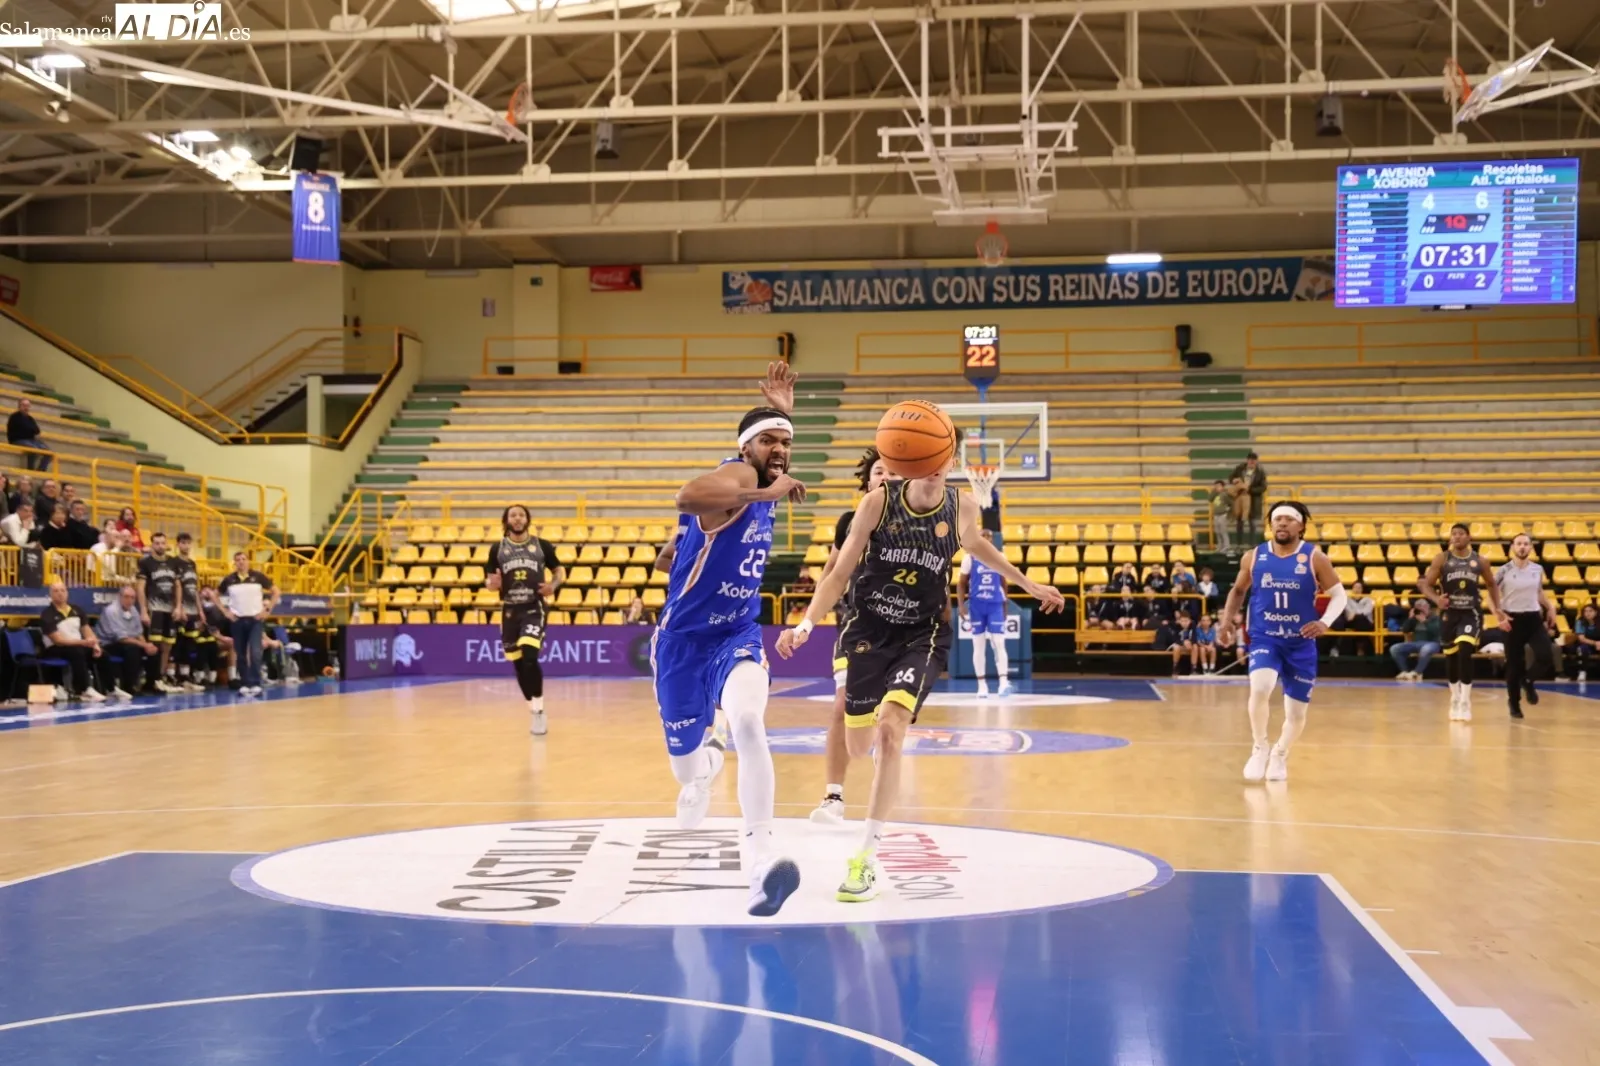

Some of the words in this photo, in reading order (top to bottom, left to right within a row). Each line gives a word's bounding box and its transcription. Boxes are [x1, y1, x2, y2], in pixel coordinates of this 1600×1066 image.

[1380, 166, 1435, 179] AVENIDA
[1483, 164, 1543, 175] Recoletas
[1373, 177, 1428, 189] XOBORG
[307, 191, 325, 224] 8
[1422, 193, 1435, 210] 4
[1475, 191, 1489, 209] 6
[1444, 215, 1467, 230] 1Q
[1420, 244, 1486, 267] 07:31
[773, 277, 925, 307] SALAMANCA
[932, 276, 986, 304] CON
[993, 274, 1041, 303] SUS
[1048, 270, 1139, 302] REINAS
[1146, 270, 1180, 299] DE
[1186, 267, 1289, 298] EUROPA
[1423, 273, 1434, 289] 0
[1475, 272, 1486, 288] 2
[965, 326, 996, 339] 07:31
[966, 345, 996, 367] 22
[739, 548, 766, 579] 22
[879, 547, 945, 575] CARBAJOSA
[513, 570, 527, 581] 32
[892, 568, 918, 585] 26
[1273, 591, 1288, 609] 11
[876, 603, 906, 618] salud
[1263, 611, 1300, 623] Xoborg
[525, 624, 541, 636] 32
[604, 828, 742, 872] LEÓN
[436, 823, 604, 912] CASTILLA
[888, 874, 964, 901] NOS
